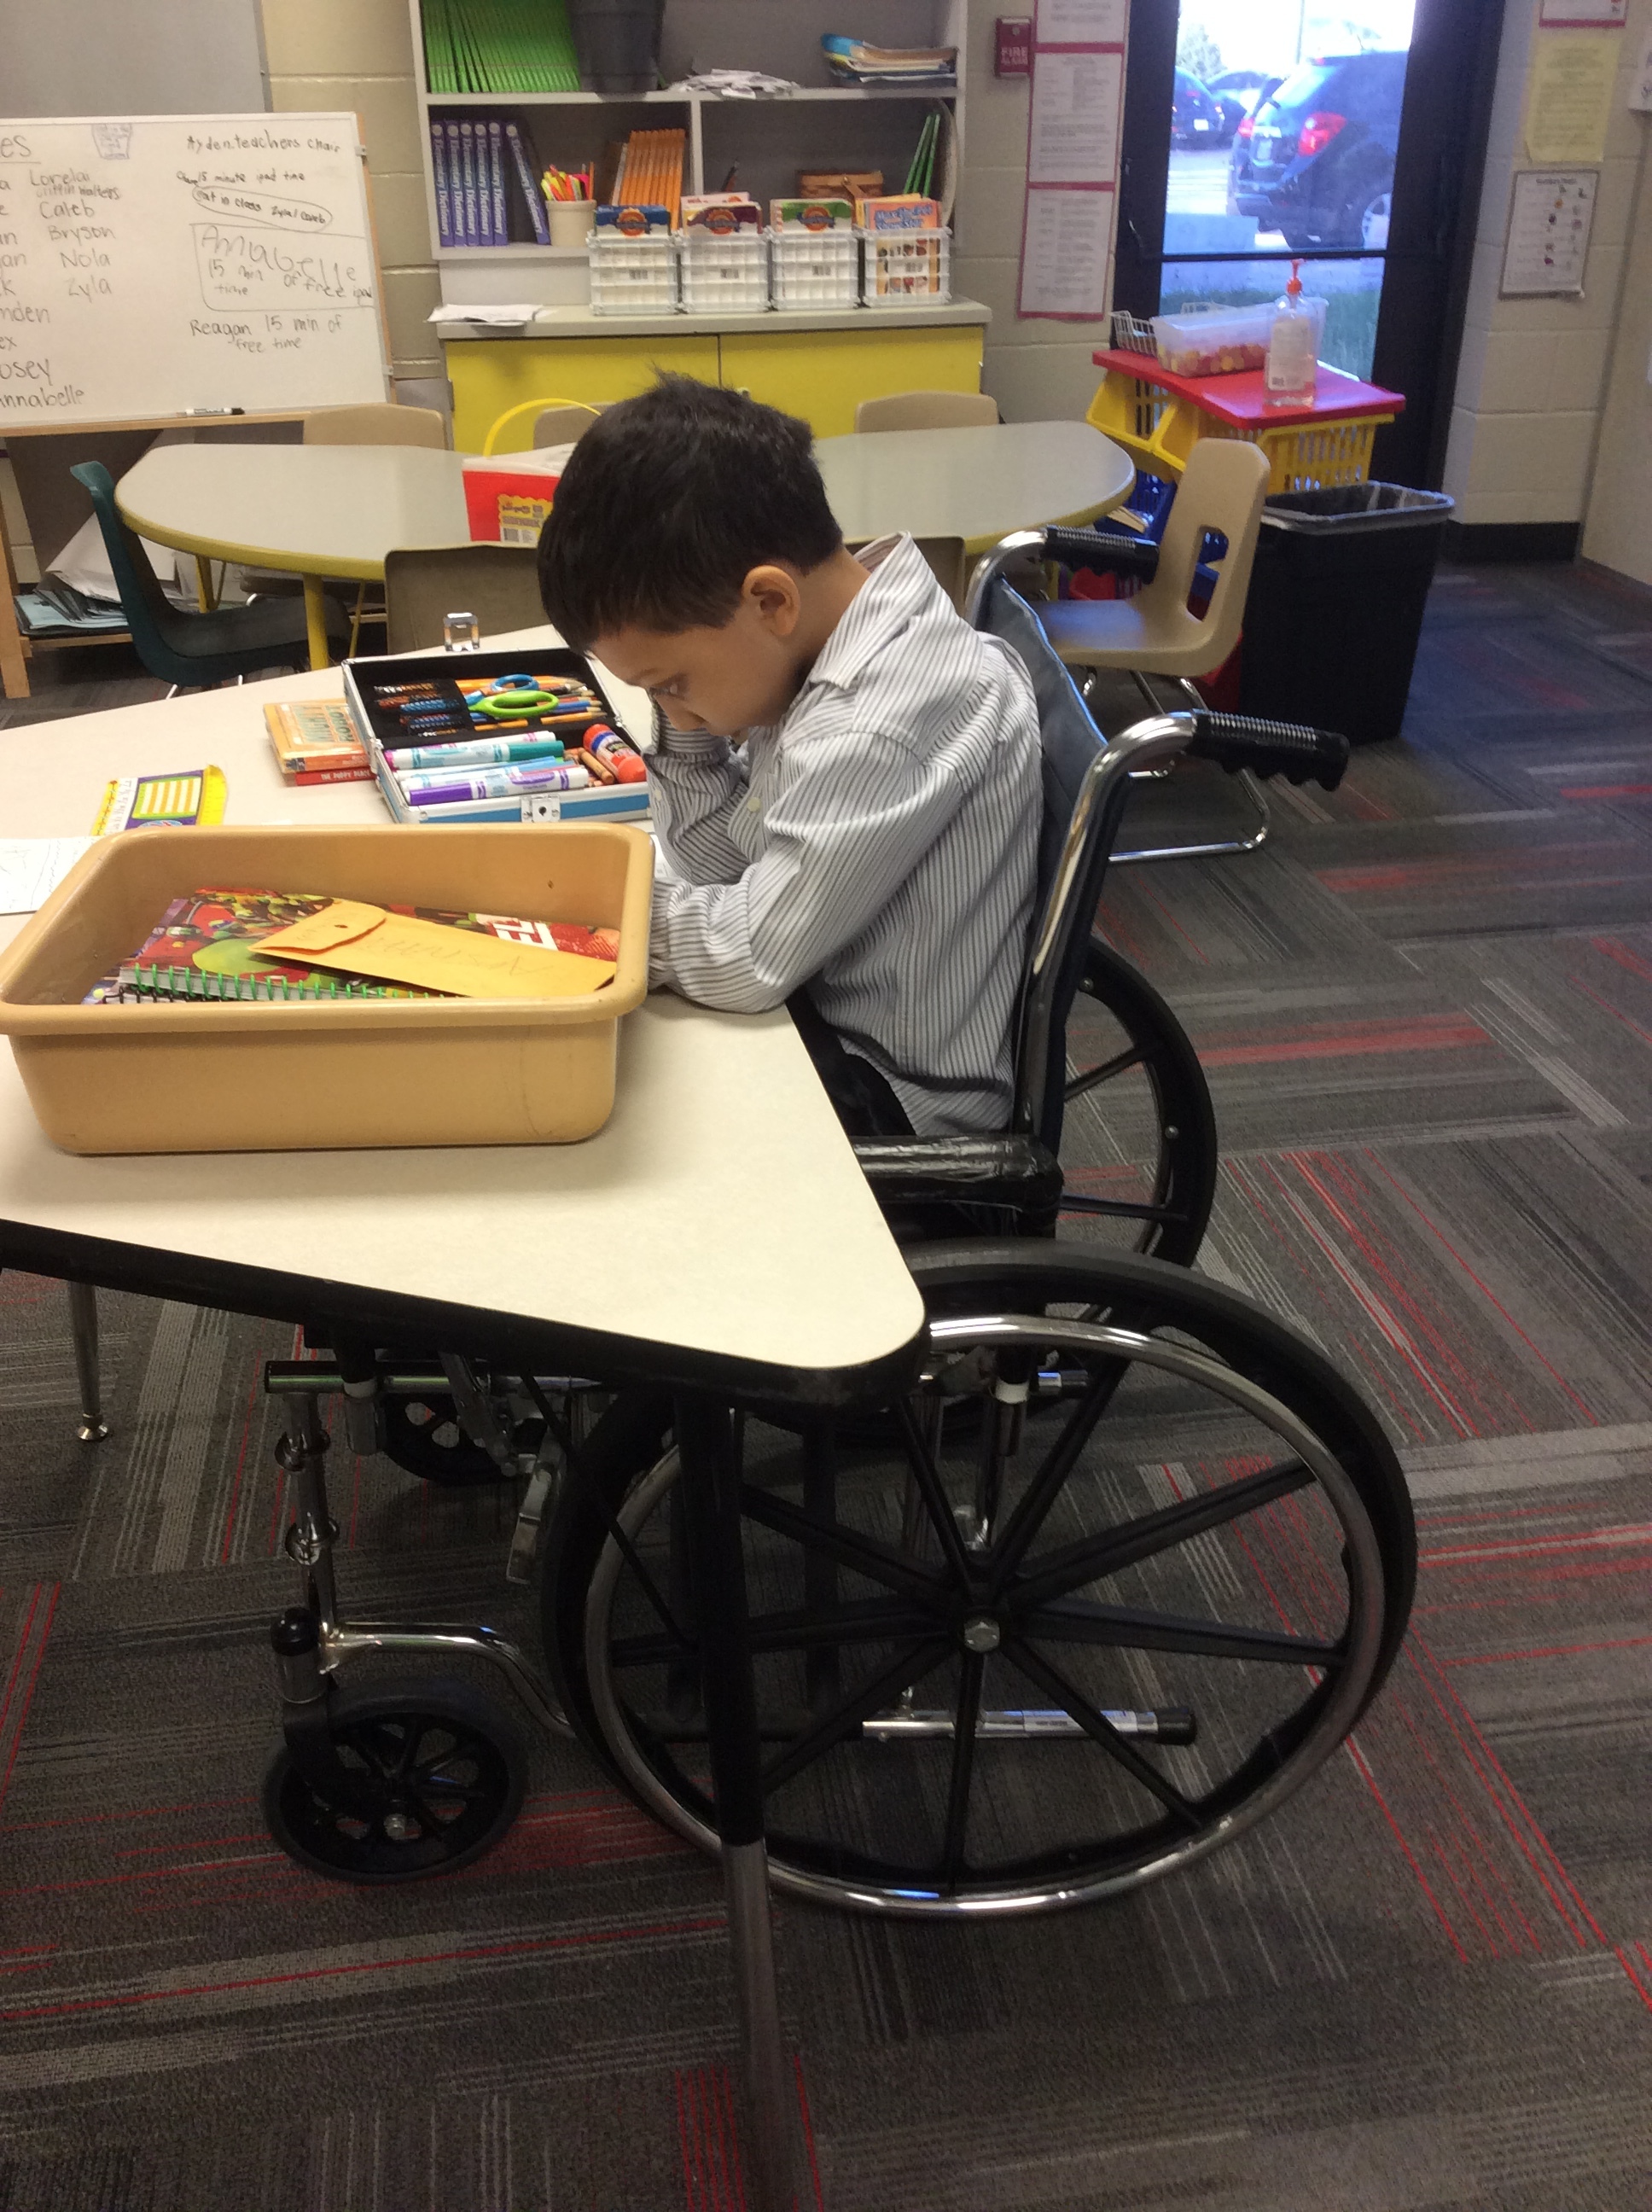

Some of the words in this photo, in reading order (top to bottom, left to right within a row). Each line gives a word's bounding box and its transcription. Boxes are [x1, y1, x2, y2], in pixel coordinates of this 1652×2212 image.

[39, 198, 96, 219] Caleb
[439, 190, 450, 236] Dictionary
[454, 190, 465, 237] Dictionary
[466, 189, 476, 236] Dictionary
[480, 189, 491, 236] Dictionary
[493, 188, 504, 235] Dictionary
[525, 189, 544, 234] Dictionary
[48, 224, 117, 247] Bryson
[59, 247, 111, 268] Nola
[189, 318, 253, 341] Reagan
[265, 313, 283, 333] 15
[294, 313, 320, 334] min
[327, 314, 344, 334] of
[272, 337, 303, 351] time
